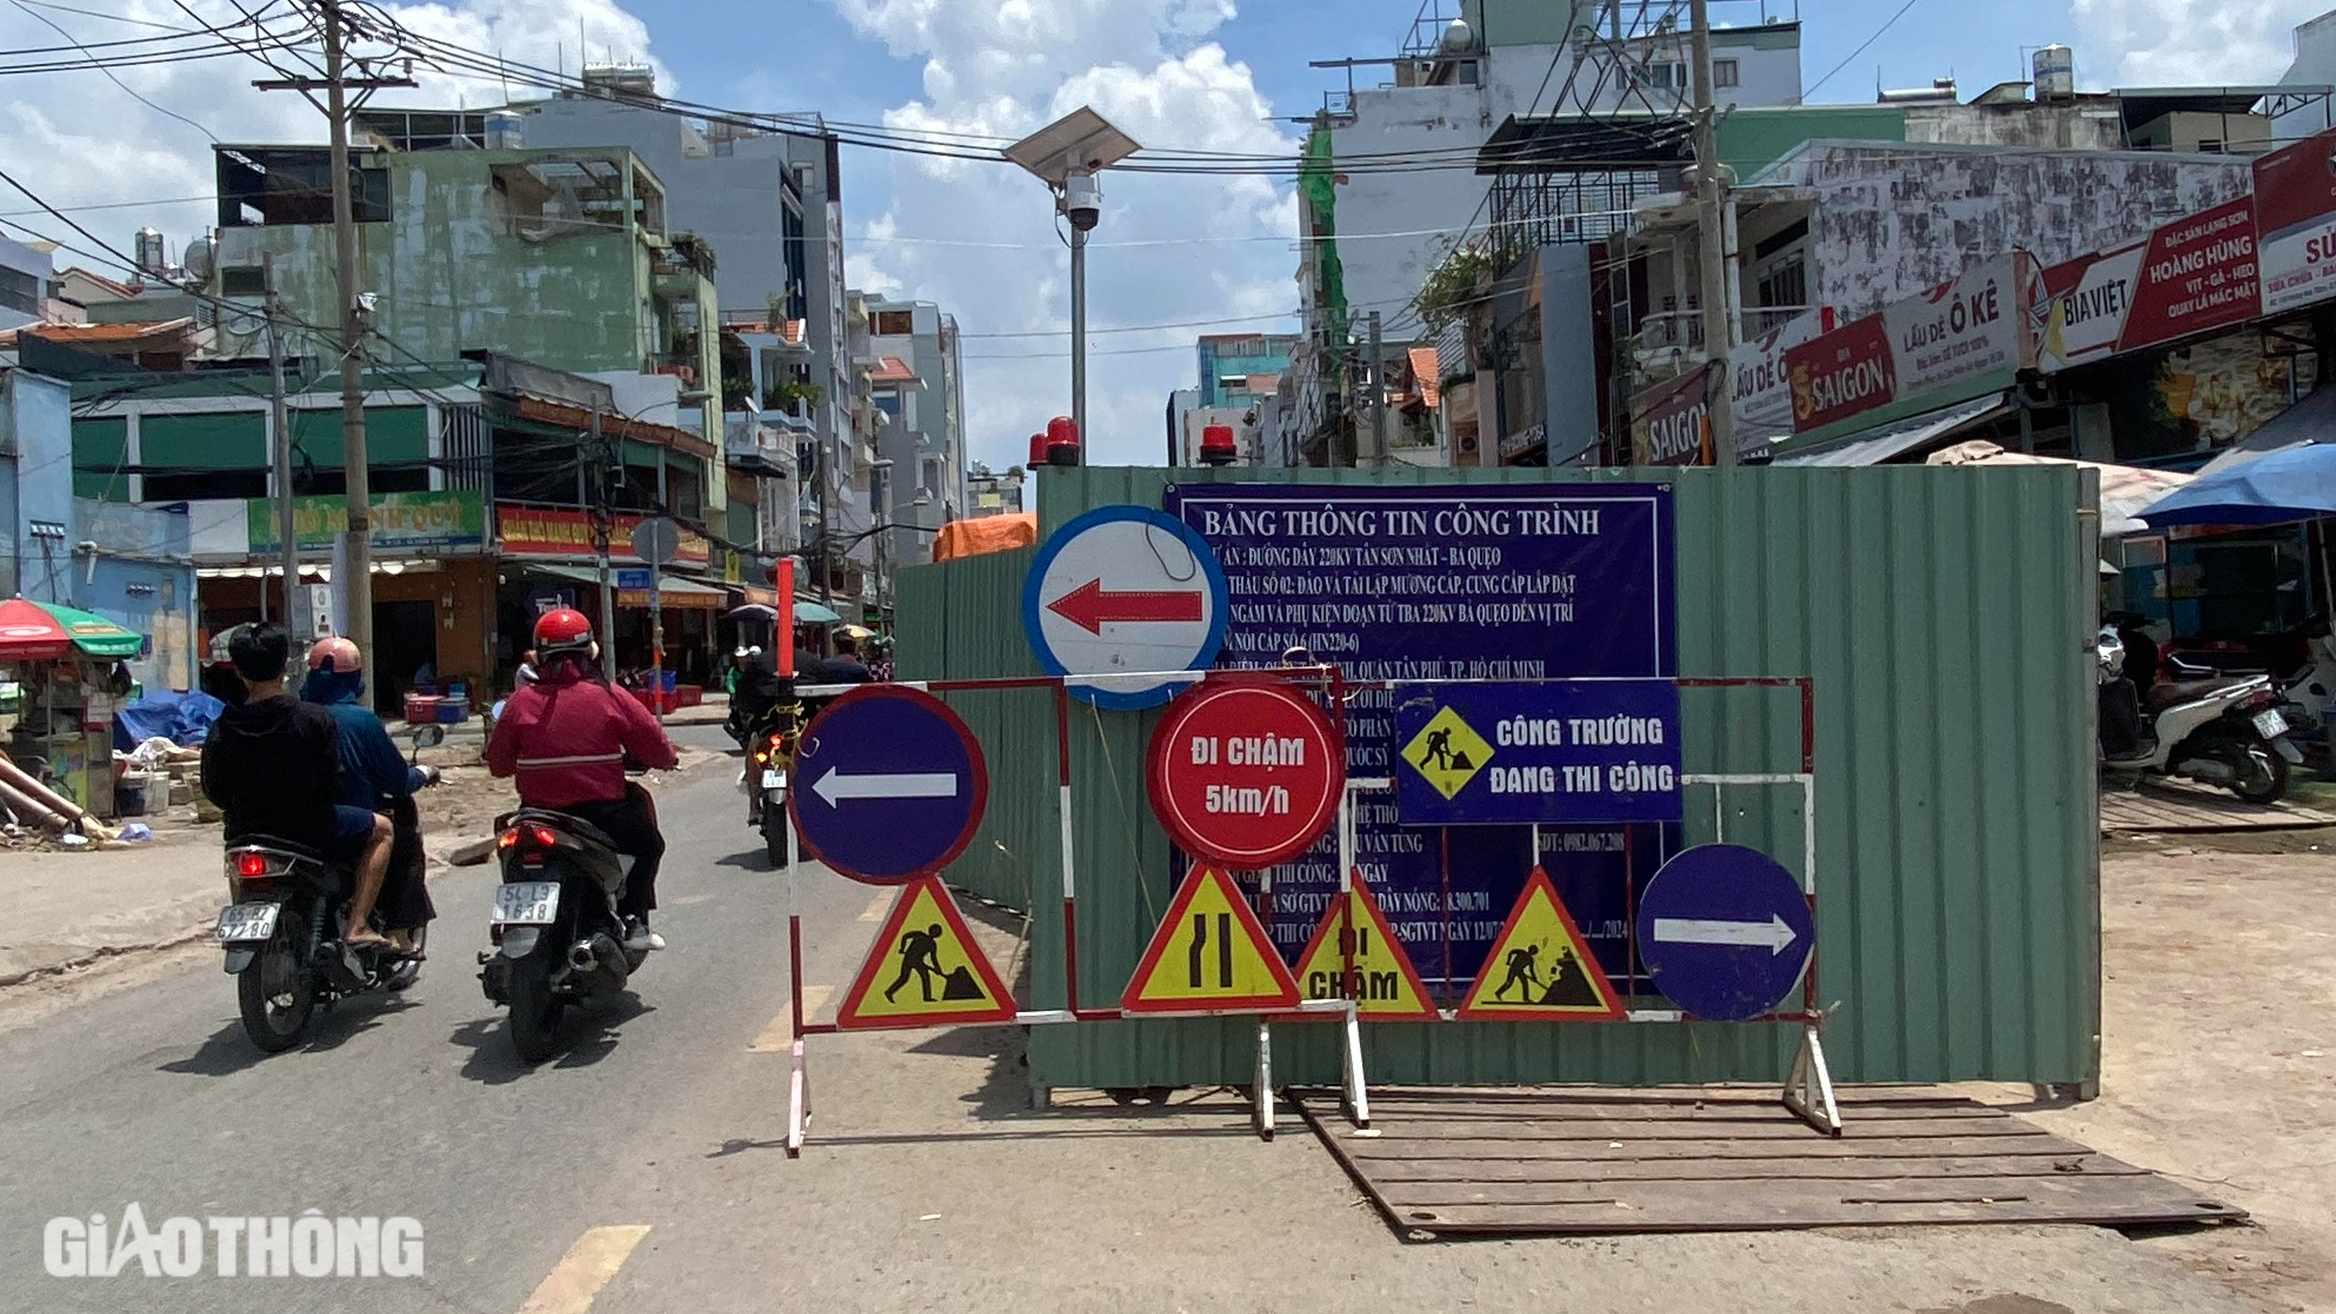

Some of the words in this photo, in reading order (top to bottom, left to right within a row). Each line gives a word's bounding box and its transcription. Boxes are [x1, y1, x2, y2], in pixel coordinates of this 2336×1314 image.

[2150, 250, 2204, 284] HOÀNG
[2206, 235, 2252, 273] HÙNG
[1971, 279, 1999, 328] KÊ
[2063, 288, 2091, 327] BIA
[2092, 278, 2127, 318] VIỆT
[1812, 354, 1885, 411] SAIGON
[1649, 402, 1706, 461] SAIGO
[1204, 504, 1276, 536] BẢNG
[1282, 504, 1376, 536] THÔNG
[1383, 511, 1428, 536] TIN
[1434, 503, 1511, 536] CÔNG
[1516, 502, 1600, 536] TRÌNH
[1466, 575, 1499, 595] CUNG
[1397, 604, 1422, 623] TBA
[1512, 661, 1546, 679] MINH
[1496, 714, 1561, 746] CÔNG
[1568, 713, 1663, 746] TRƯỜNG
[1191, 736, 1218, 765] ĐI
[1228, 732, 1305, 772] CHẬM
[1489, 766, 1554, 793] ĐANG
[1562, 766, 1600, 793] THI
[1608, 760, 1673, 793] CÔNG
[1206, 785, 1289, 817] 5km/h
